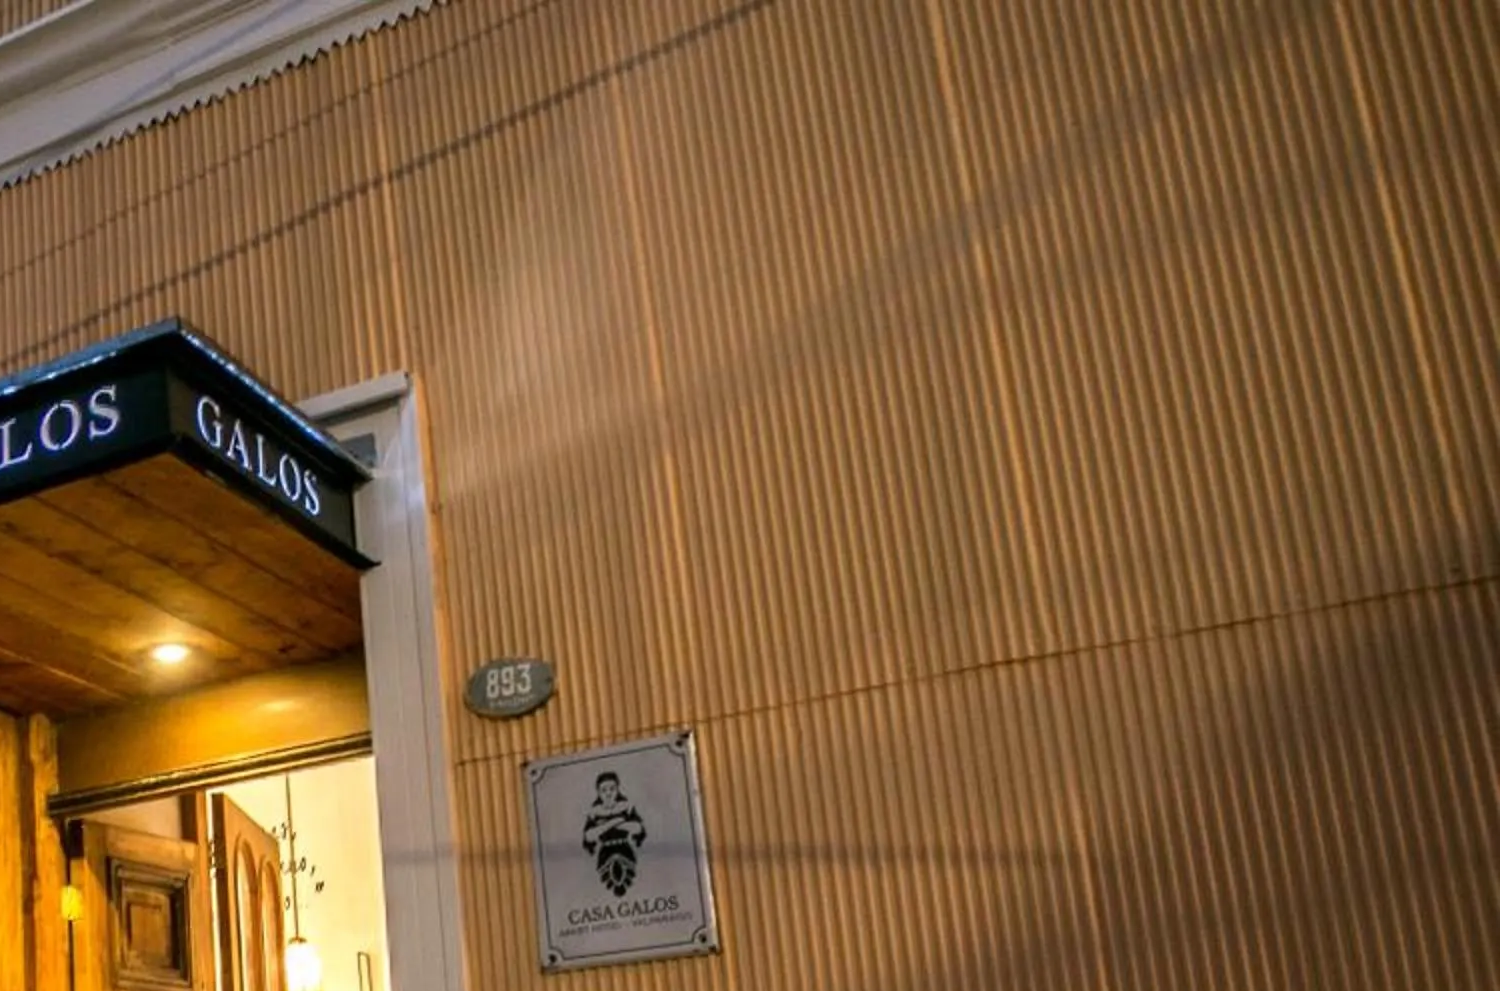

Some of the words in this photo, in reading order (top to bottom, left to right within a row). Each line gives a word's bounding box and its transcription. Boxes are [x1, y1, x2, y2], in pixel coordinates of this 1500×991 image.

[197, 395, 320, 516] GALOS
[485, 663, 532, 699] 893
[567, 904, 615, 925] CASA
[617, 895, 680, 917] GALOS
